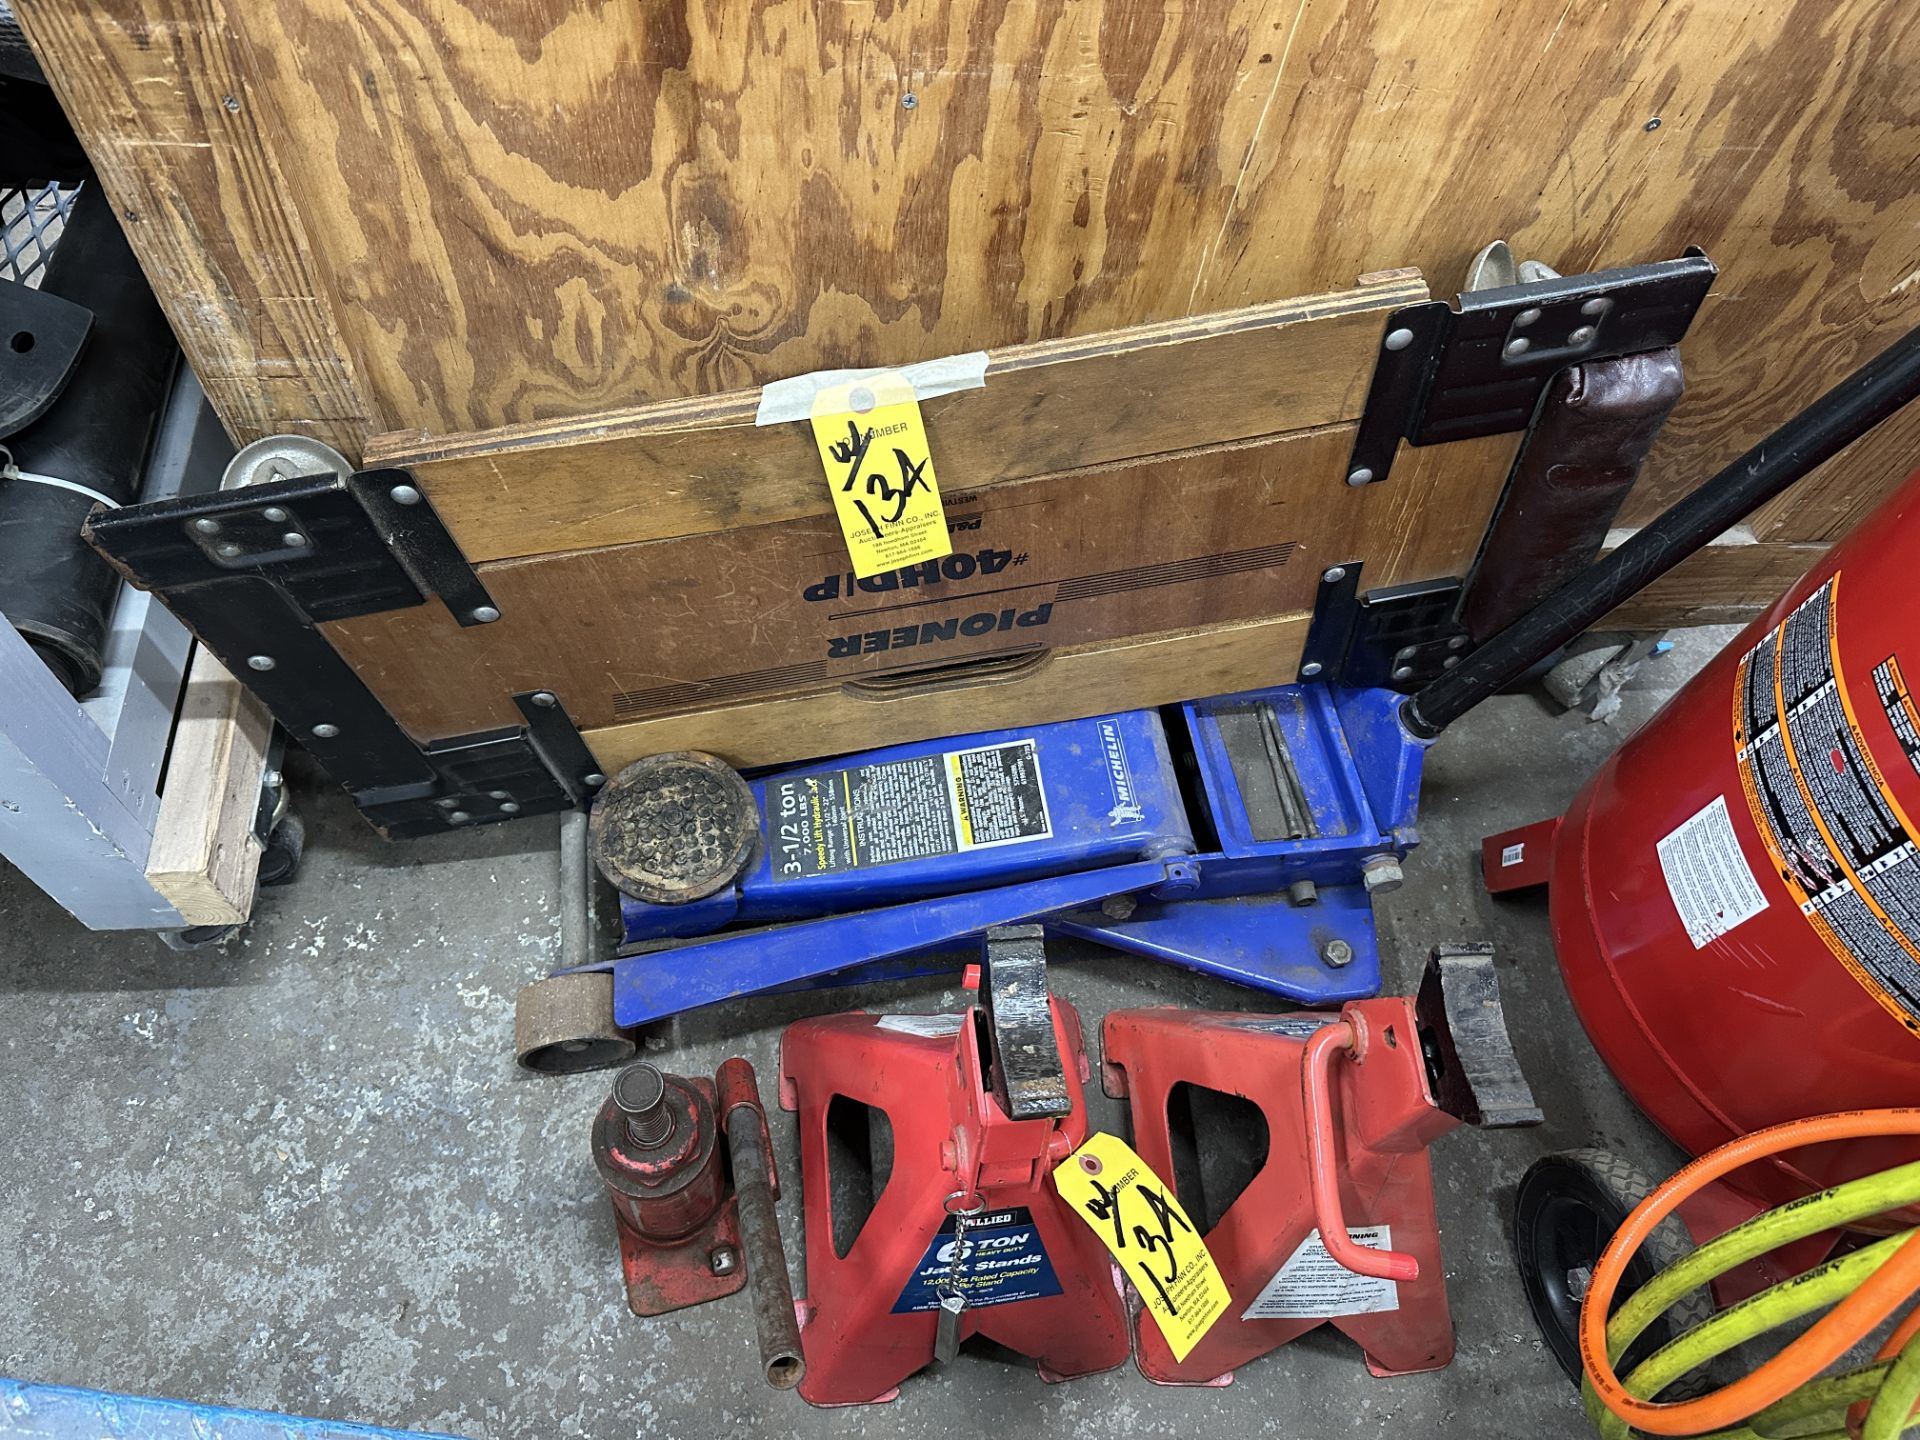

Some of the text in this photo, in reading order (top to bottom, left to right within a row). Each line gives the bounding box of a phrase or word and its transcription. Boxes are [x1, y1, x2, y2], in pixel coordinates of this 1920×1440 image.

[854, 448, 931, 538] 13A
[849, 524, 883, 538] JOSEH
[885, 520, 904, 529] FINN
[924, 510, 941, 519] INC.
[827, 603, 1053, 659] PIONEER
[1105, 725, 1129, 803] MICHELIN
[1854, 731, 1884, 787] ADVERTENCIA
[798, 794, 807, 816] LBS
[956, 777, 966, 814] WARNING
[811, 796, 822, 828] Hydraulic
[853, 790, 866, 846] INSTRUCIONS
[781, 784, 801, 873] 3-1/2 ton
[814, 829, 823, 841] Lift
[841, 822, 849, 848] Universal
[816, 843, 827, 869] Speedy
[1889, 926, 1920, 963] ATTENTIO
[966, 1215, 1011, 1226] ALLIED
[937, 1234, 1029, 1262] 6 TON
[1133, 1184, 1192, 1316] 13A
[970, 1274, 997, 1282] Rated
[1000, 1268, 1039, 1278] Capacity
[976, 1255, 1041, 1270] Stands
[977, 1278, 1003, 1287] Stand
[1154, 1285, 1175, 1309] JOSPH
